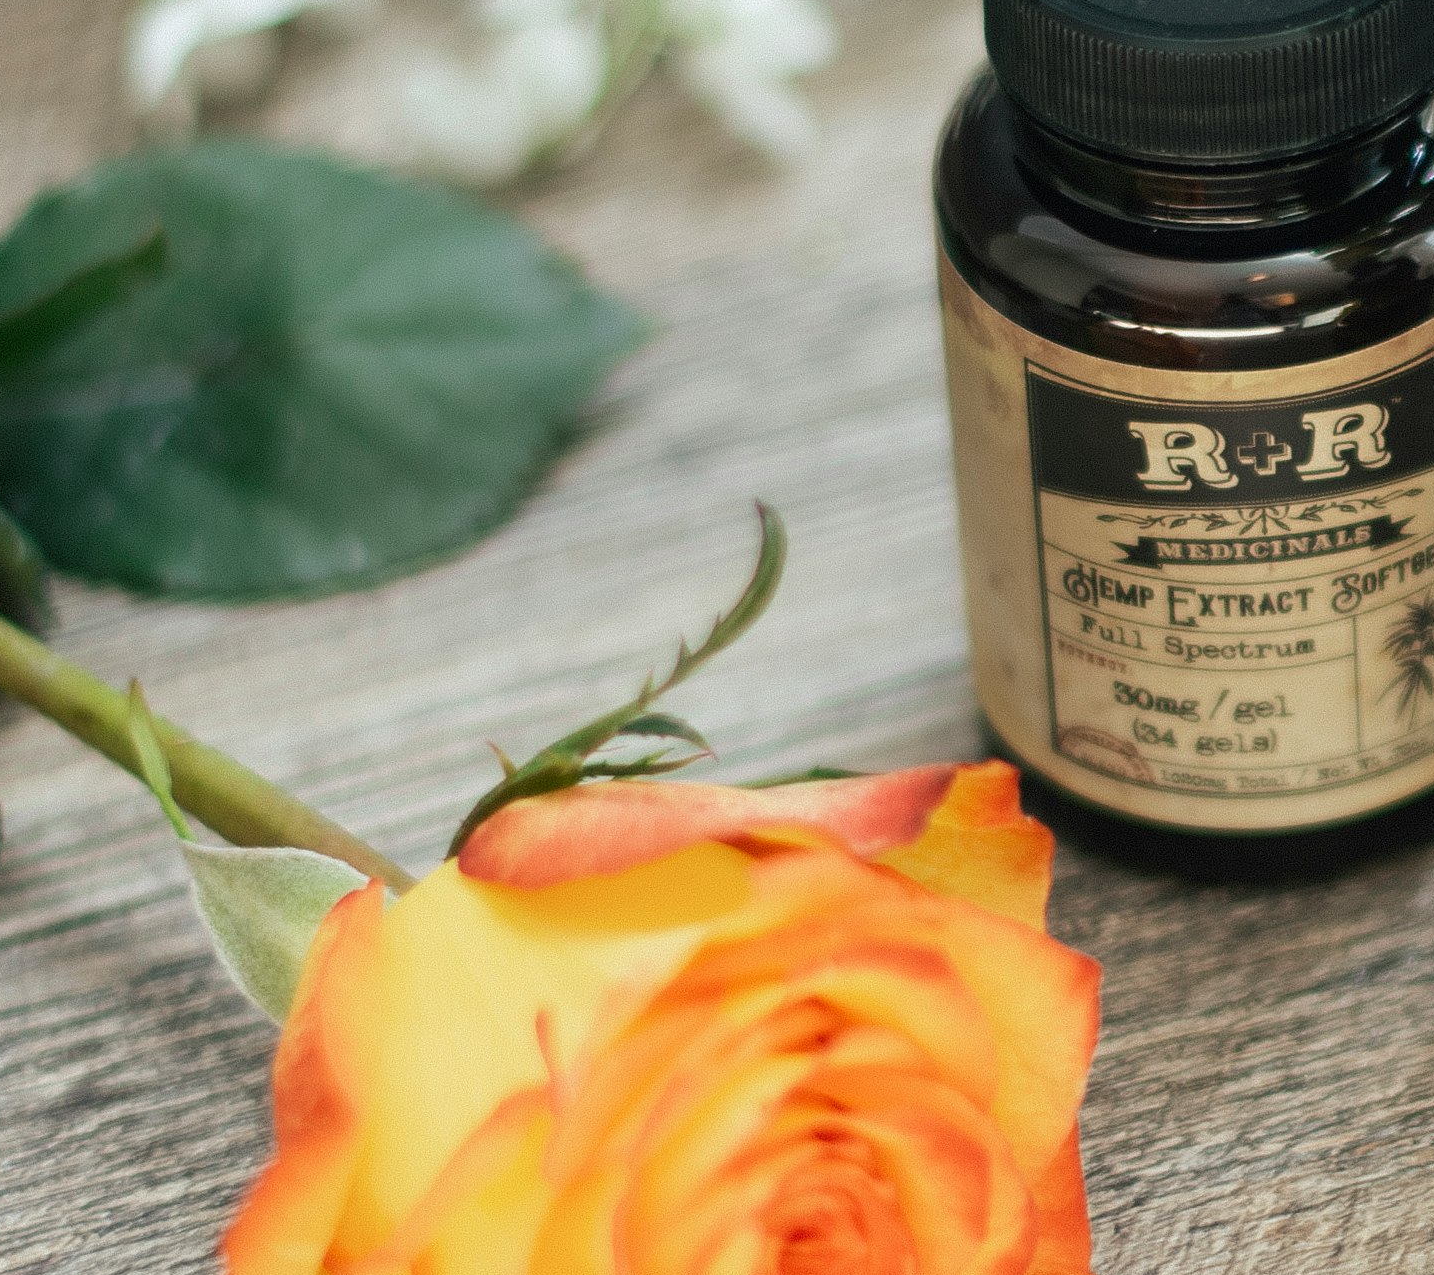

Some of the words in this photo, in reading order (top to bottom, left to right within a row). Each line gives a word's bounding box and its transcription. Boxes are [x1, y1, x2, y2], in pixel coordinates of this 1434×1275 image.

[1128, 403, 1392, 490] R+R
[1156, 525, 1372, 560] MEDICINALS
[1166, 588, 1315, 627] EXTRACT
[1080, 613, 1147, 651] Full
[1164, 635, 1315, 664] Spectrum
[1194, 729, 1277, 757] gels)
